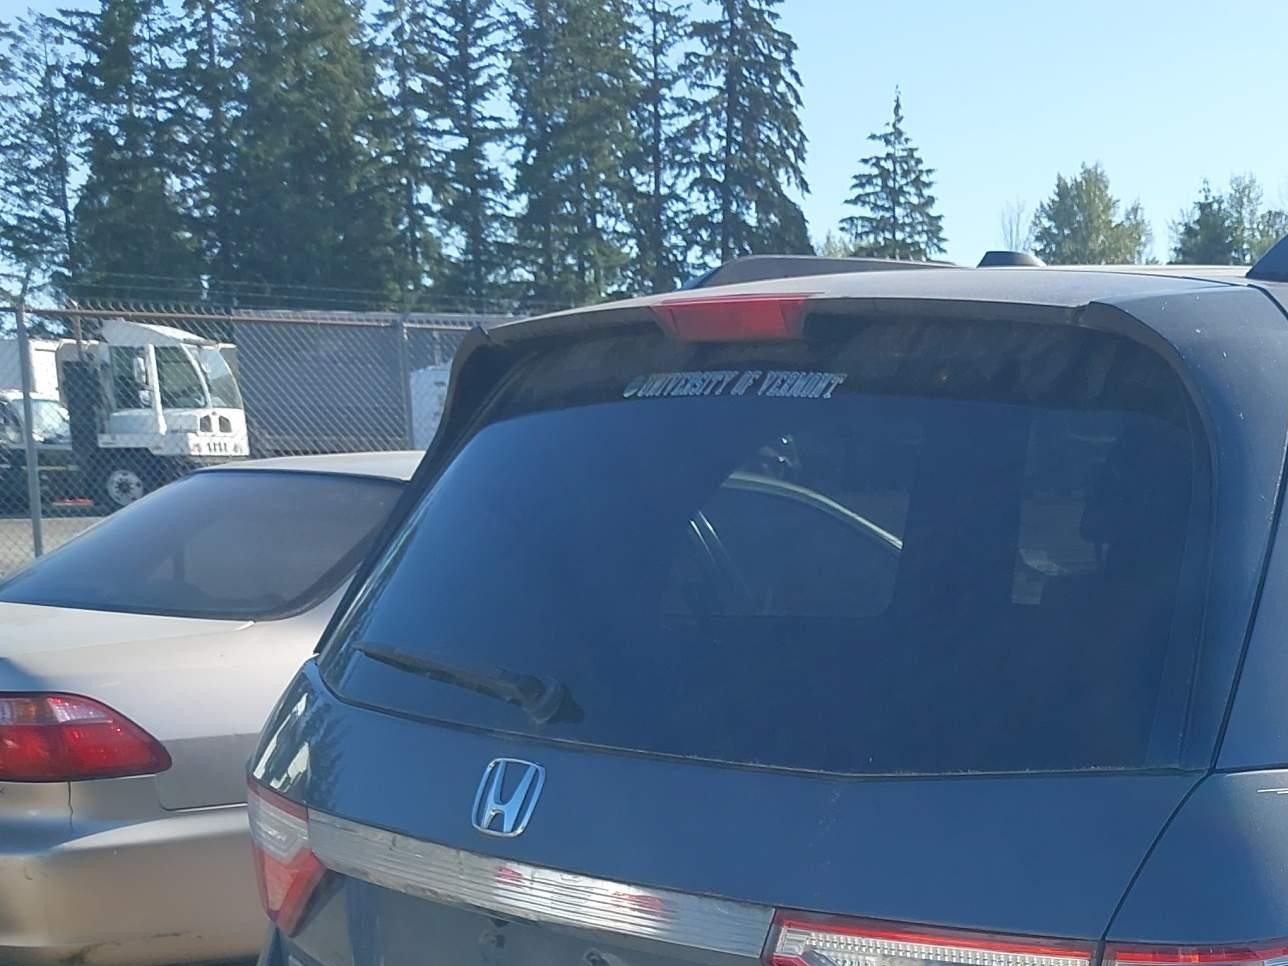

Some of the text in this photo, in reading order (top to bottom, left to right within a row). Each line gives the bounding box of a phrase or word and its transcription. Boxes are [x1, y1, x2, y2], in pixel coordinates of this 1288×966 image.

[637, 370, 847, 398] UNIVERSITY OF VERMONT
